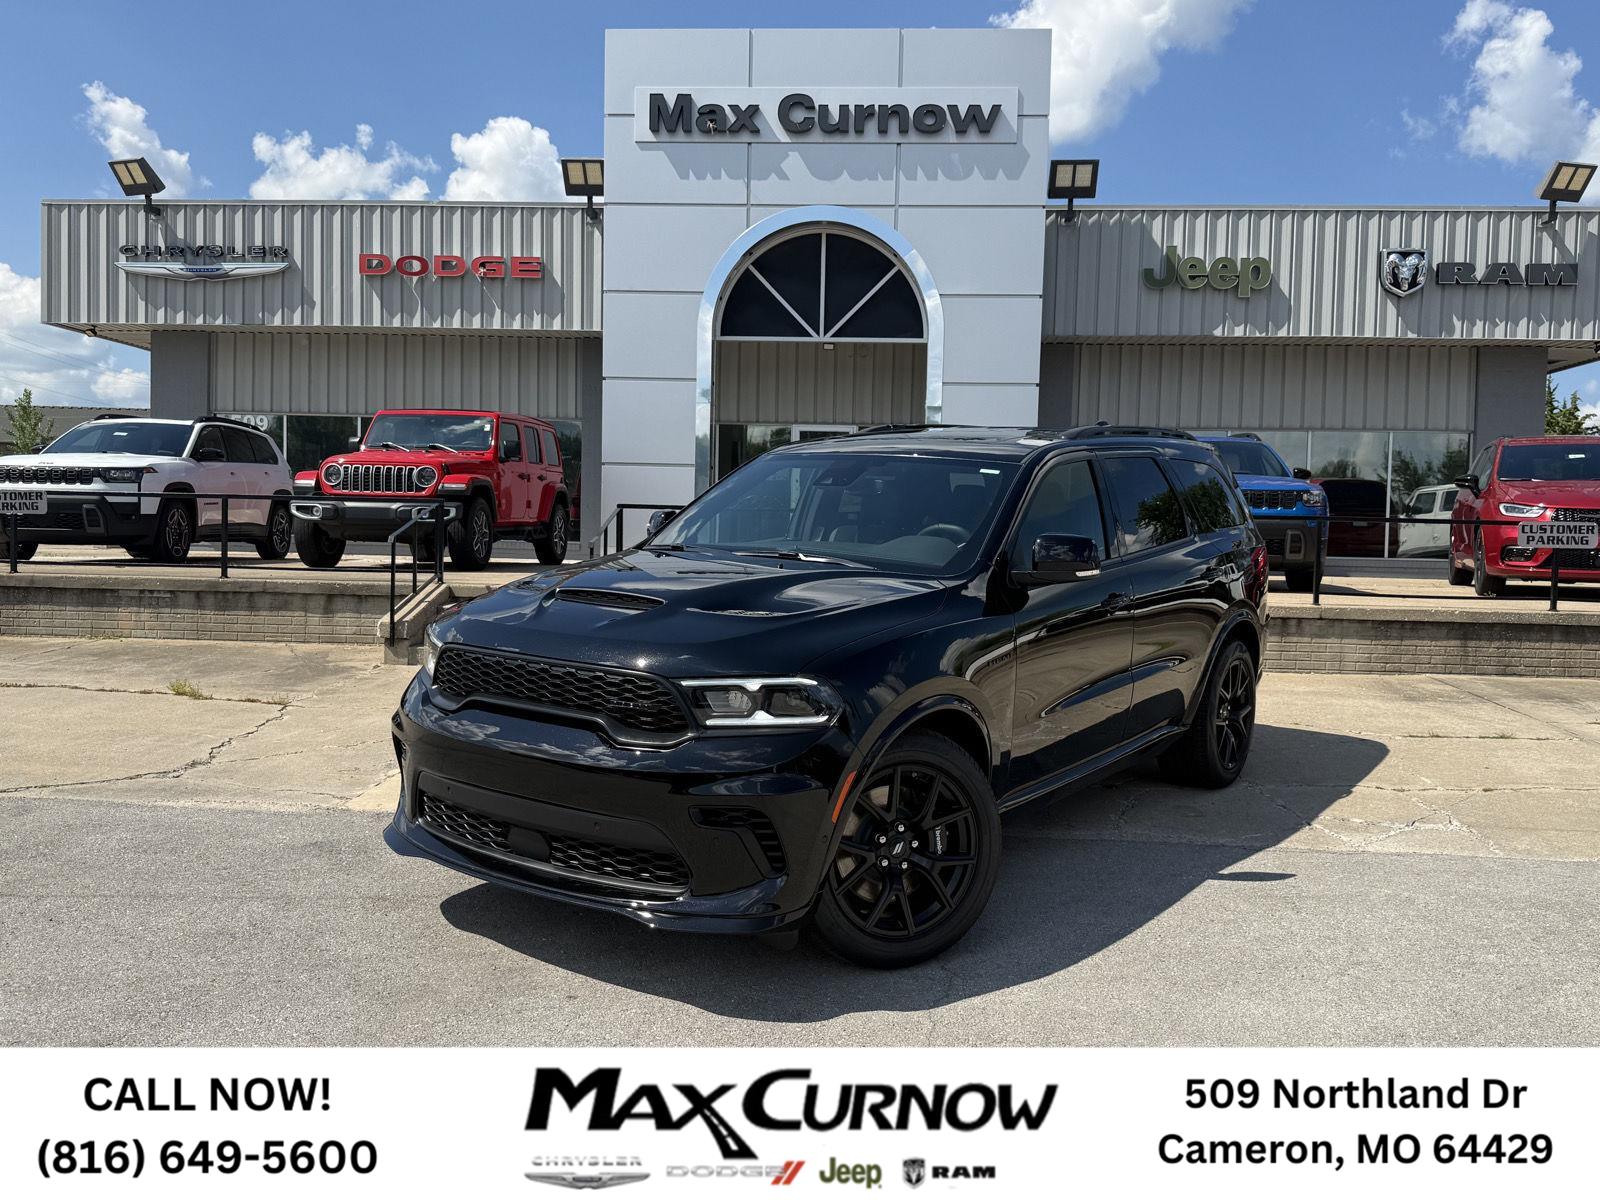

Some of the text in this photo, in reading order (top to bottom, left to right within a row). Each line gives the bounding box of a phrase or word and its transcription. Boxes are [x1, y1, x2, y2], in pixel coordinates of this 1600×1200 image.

[649, 93, 1002, 134] Max Curnow
[119, 244, 288, 257] CHRYSLER
[359, 253, 544, 278] DODGE
[1143, 246, 1272, 298] Jeep
[1437, 263, 1579, 285] RAM
[0, 491, 43, 501] TOMER
[0, 501, 39, 511] RKING
[1521, 524, 1595, 535] CUSTOMER
[1526, 535, 1589, 546] PARKING
